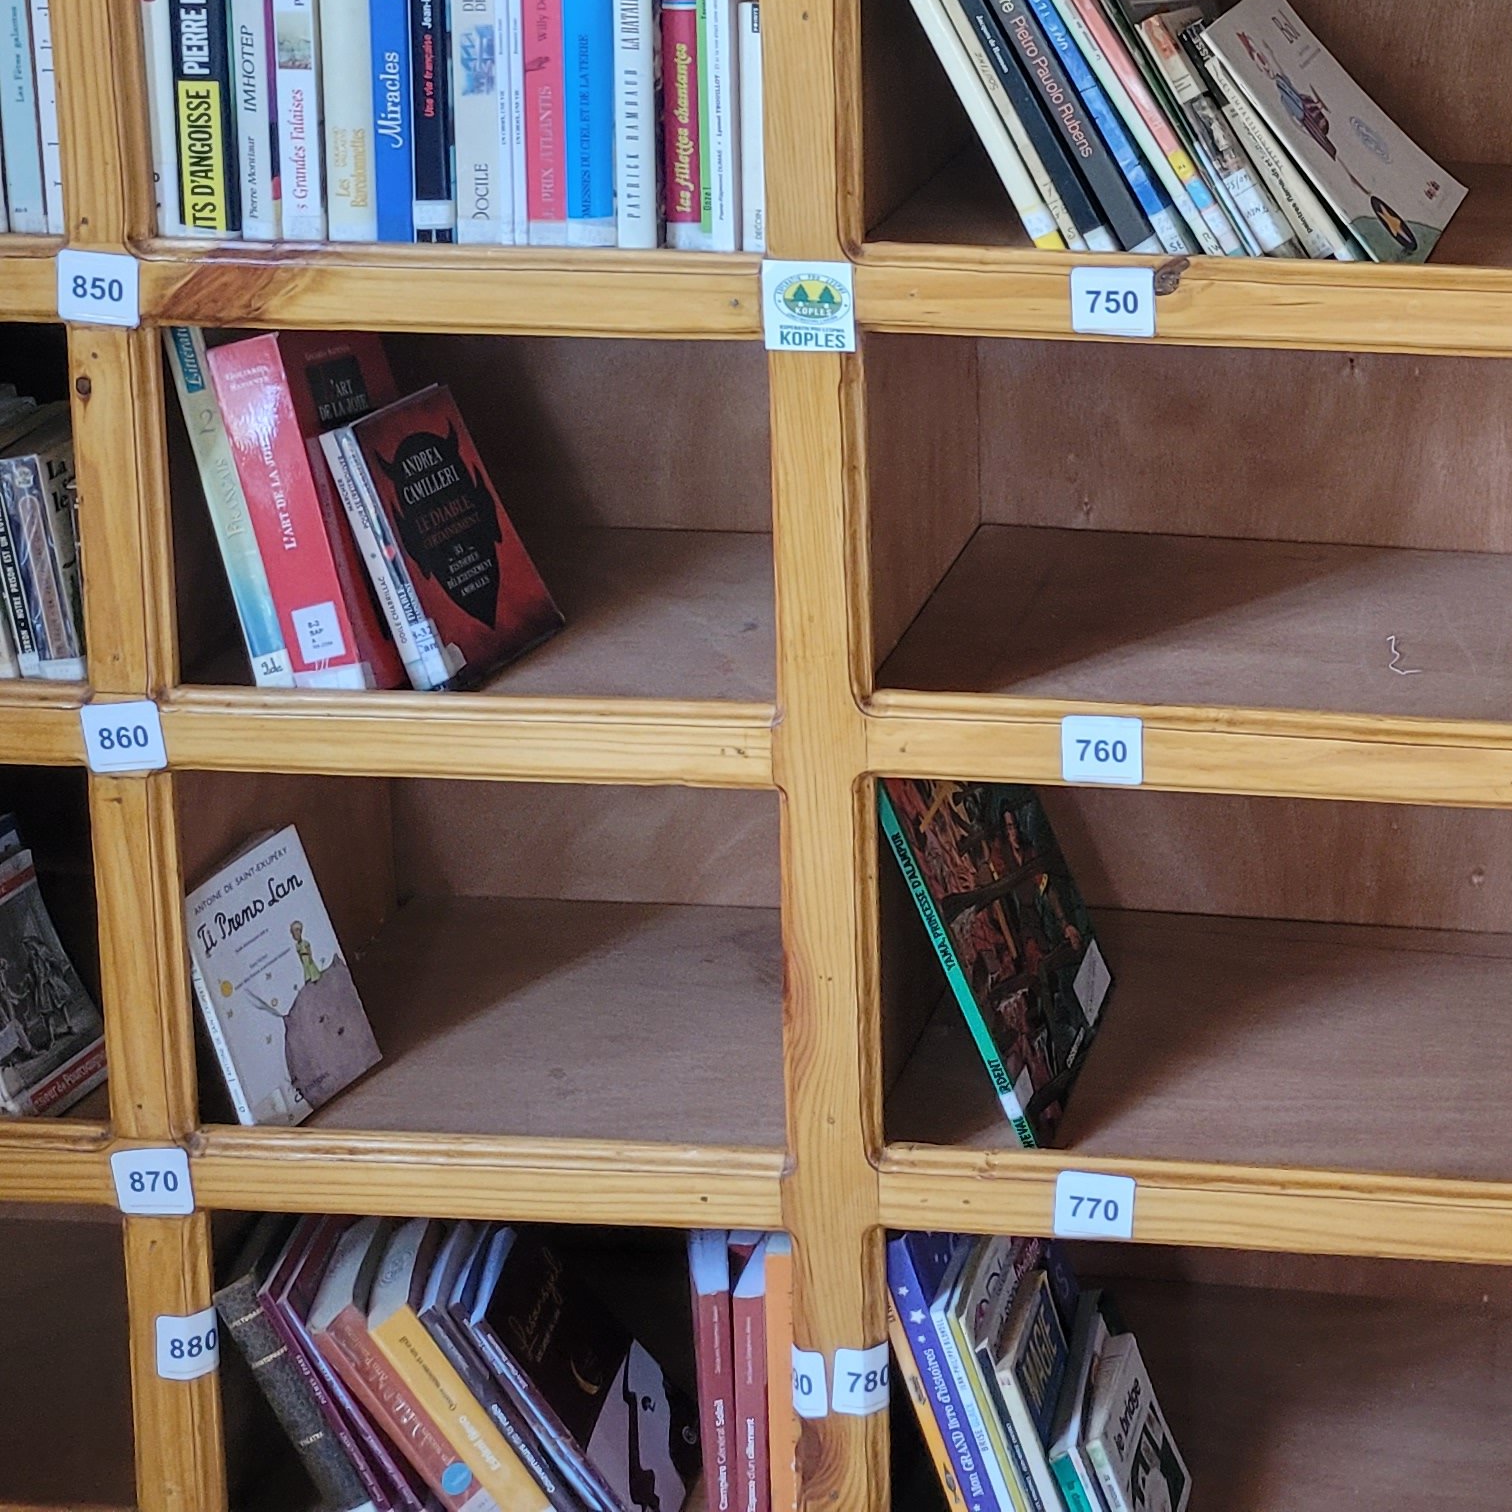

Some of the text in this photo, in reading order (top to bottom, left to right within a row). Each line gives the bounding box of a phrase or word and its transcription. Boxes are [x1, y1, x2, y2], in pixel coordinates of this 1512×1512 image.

[180, 7, 211, 76] PIERRE
[620, 36, 639, 52] LA
[240, 24, 259, 114] IMHOTEP
[1009, 15, 1043, 59] Pietro
[1030, 55, 1069, 107] Pauolo
[1056, 101, 1098, 160] Rubens
[377, 51, 403, 149] Miracles
[535, 13, 556, 204] PRIX ATLANTIS Willy
[577, 34, 591, 168] DU CIEL TERRE
[186, 88, 217, 198] D'ANGOISSE
[288, 88, 309, 200] Grandes Falaises
[626, 153, 641, 220] PATRICK
[72, 275, 123, 302] 850
[1085, 290, 1139, 314] 750
[779, 329, 847, 349] KOPLES
[398, 443, 445, 479] ANDREA
[399, 462, 463, 506] CAMILLERI
[272, 488, 298, 550] L'ART DE
[5, 564, 19, 593] PRISON
[98, 725, 149, 750] 860
[1075, 739, 1128, 763] 760
[215, 872, 304, 942] Prens Lan
[914, 888, 943, 939] PRINCESSE
[129, 1170, 179, 1193] 870
[1069, 1195, 1119, 1222] 770
[169, 1328, 216, 1359] 880
[847, 1365, 888, 1393] 780
[1115, 1374, 1146, 1435] bridge
[949, 1427, 986, 1499] Mon GRAND
